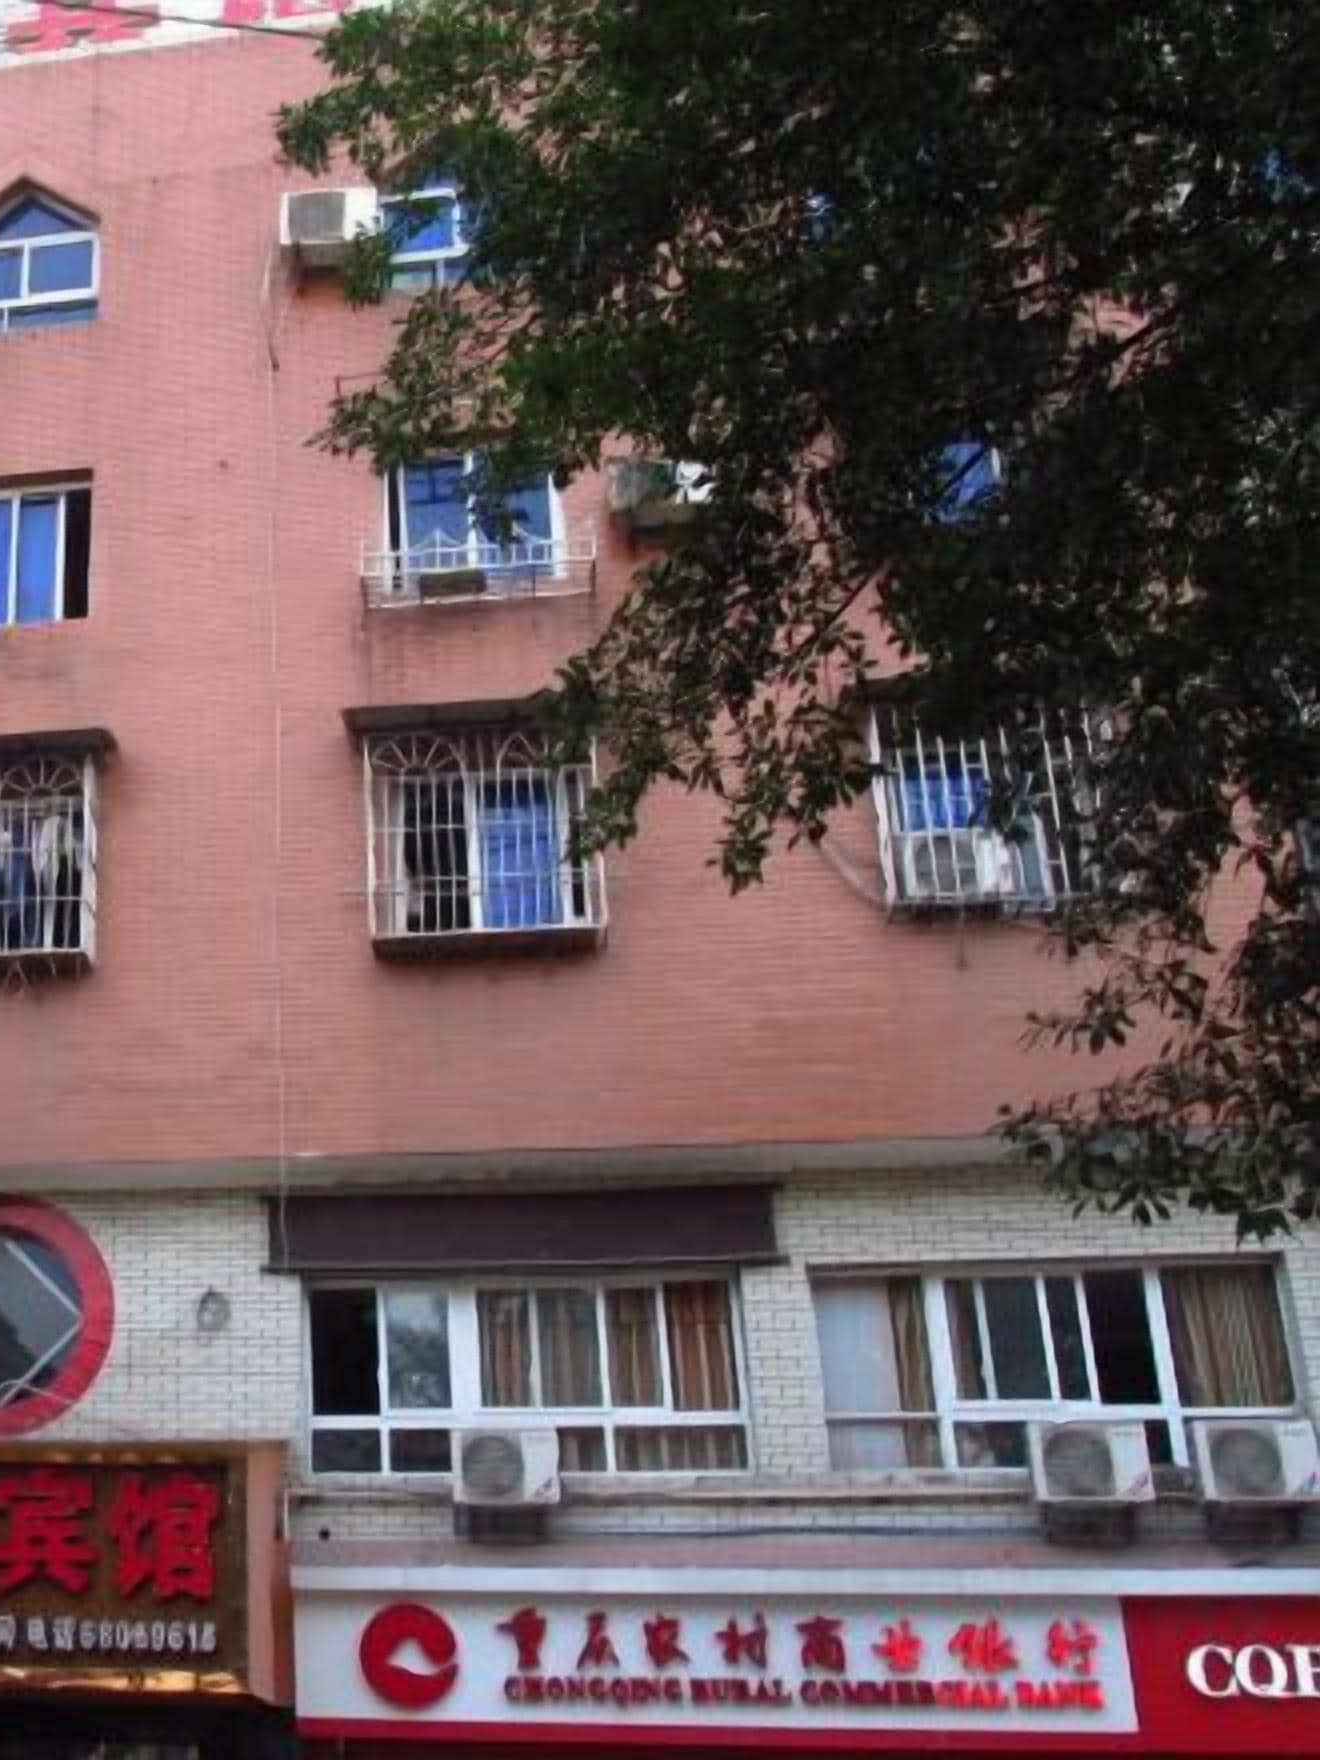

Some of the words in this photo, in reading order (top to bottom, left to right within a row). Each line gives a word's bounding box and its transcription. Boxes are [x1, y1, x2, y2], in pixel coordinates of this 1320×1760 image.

[496, 1606, 1098, 1672] 重庆农村商业银行
[503, 1675, 683, 1710] CHONGQING
[689, 1676, 793, 1707] RURAL
[800, 1678, 1009, 1710] COMMERCIAL
[1015, 1678, 1105, 1711] BANK
